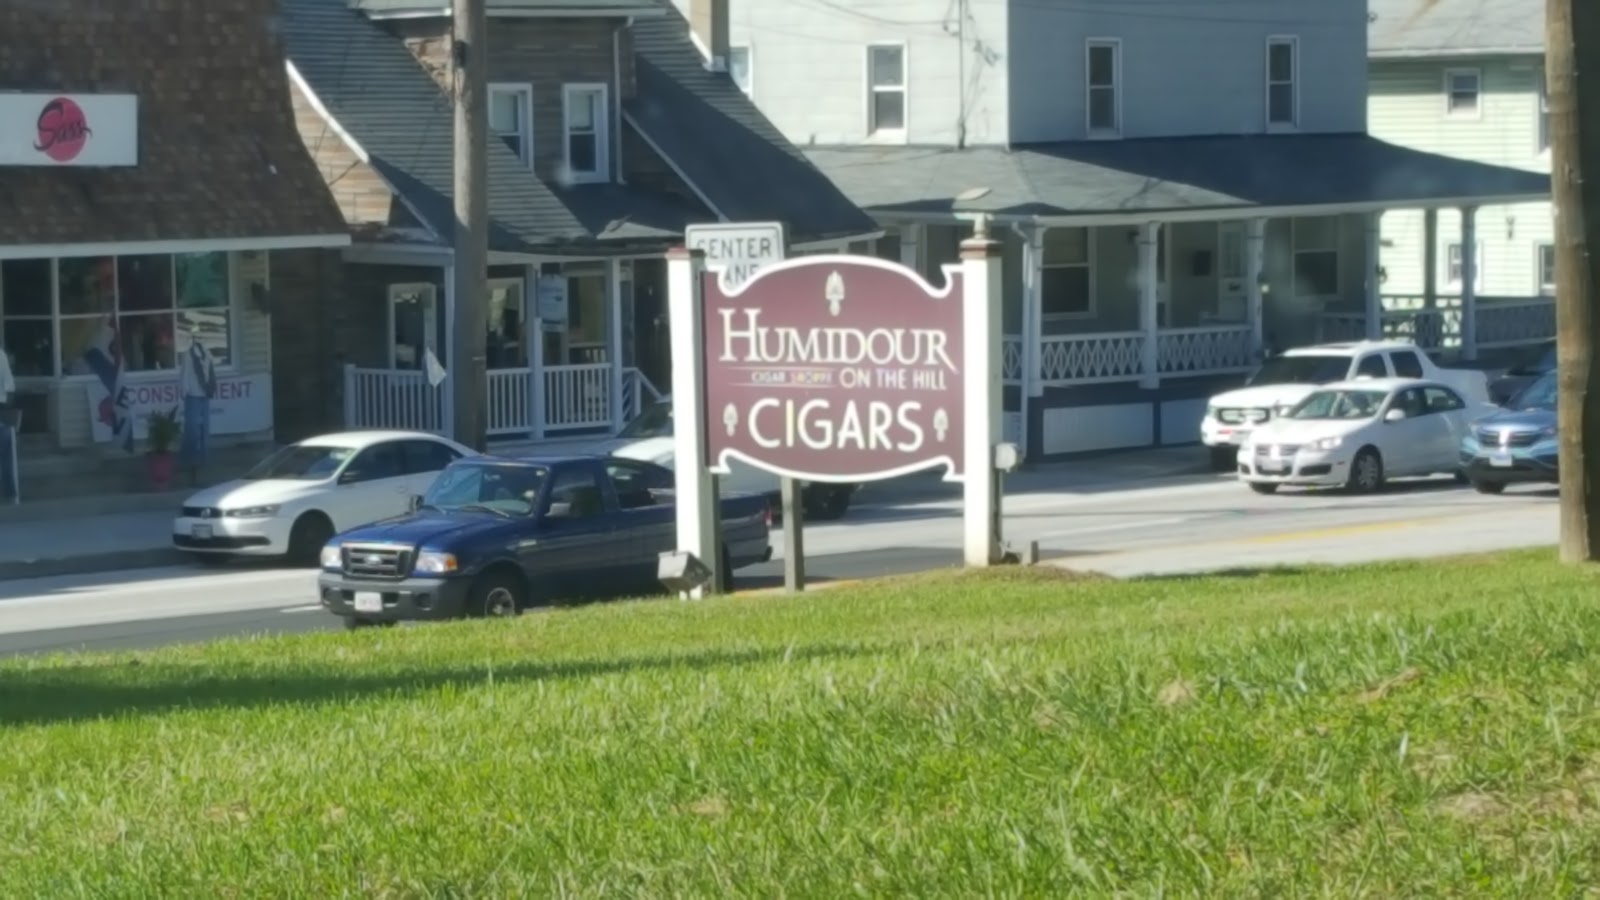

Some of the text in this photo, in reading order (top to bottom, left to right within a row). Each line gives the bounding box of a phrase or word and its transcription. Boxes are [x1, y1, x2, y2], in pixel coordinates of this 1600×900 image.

[33, 101, 93, 151] Sass
[718, 308, 957, 374] HUMIDOUR
[839, 367, 947, 390] ON THE HILL
[748, 397, 924, 452] CIGARS
